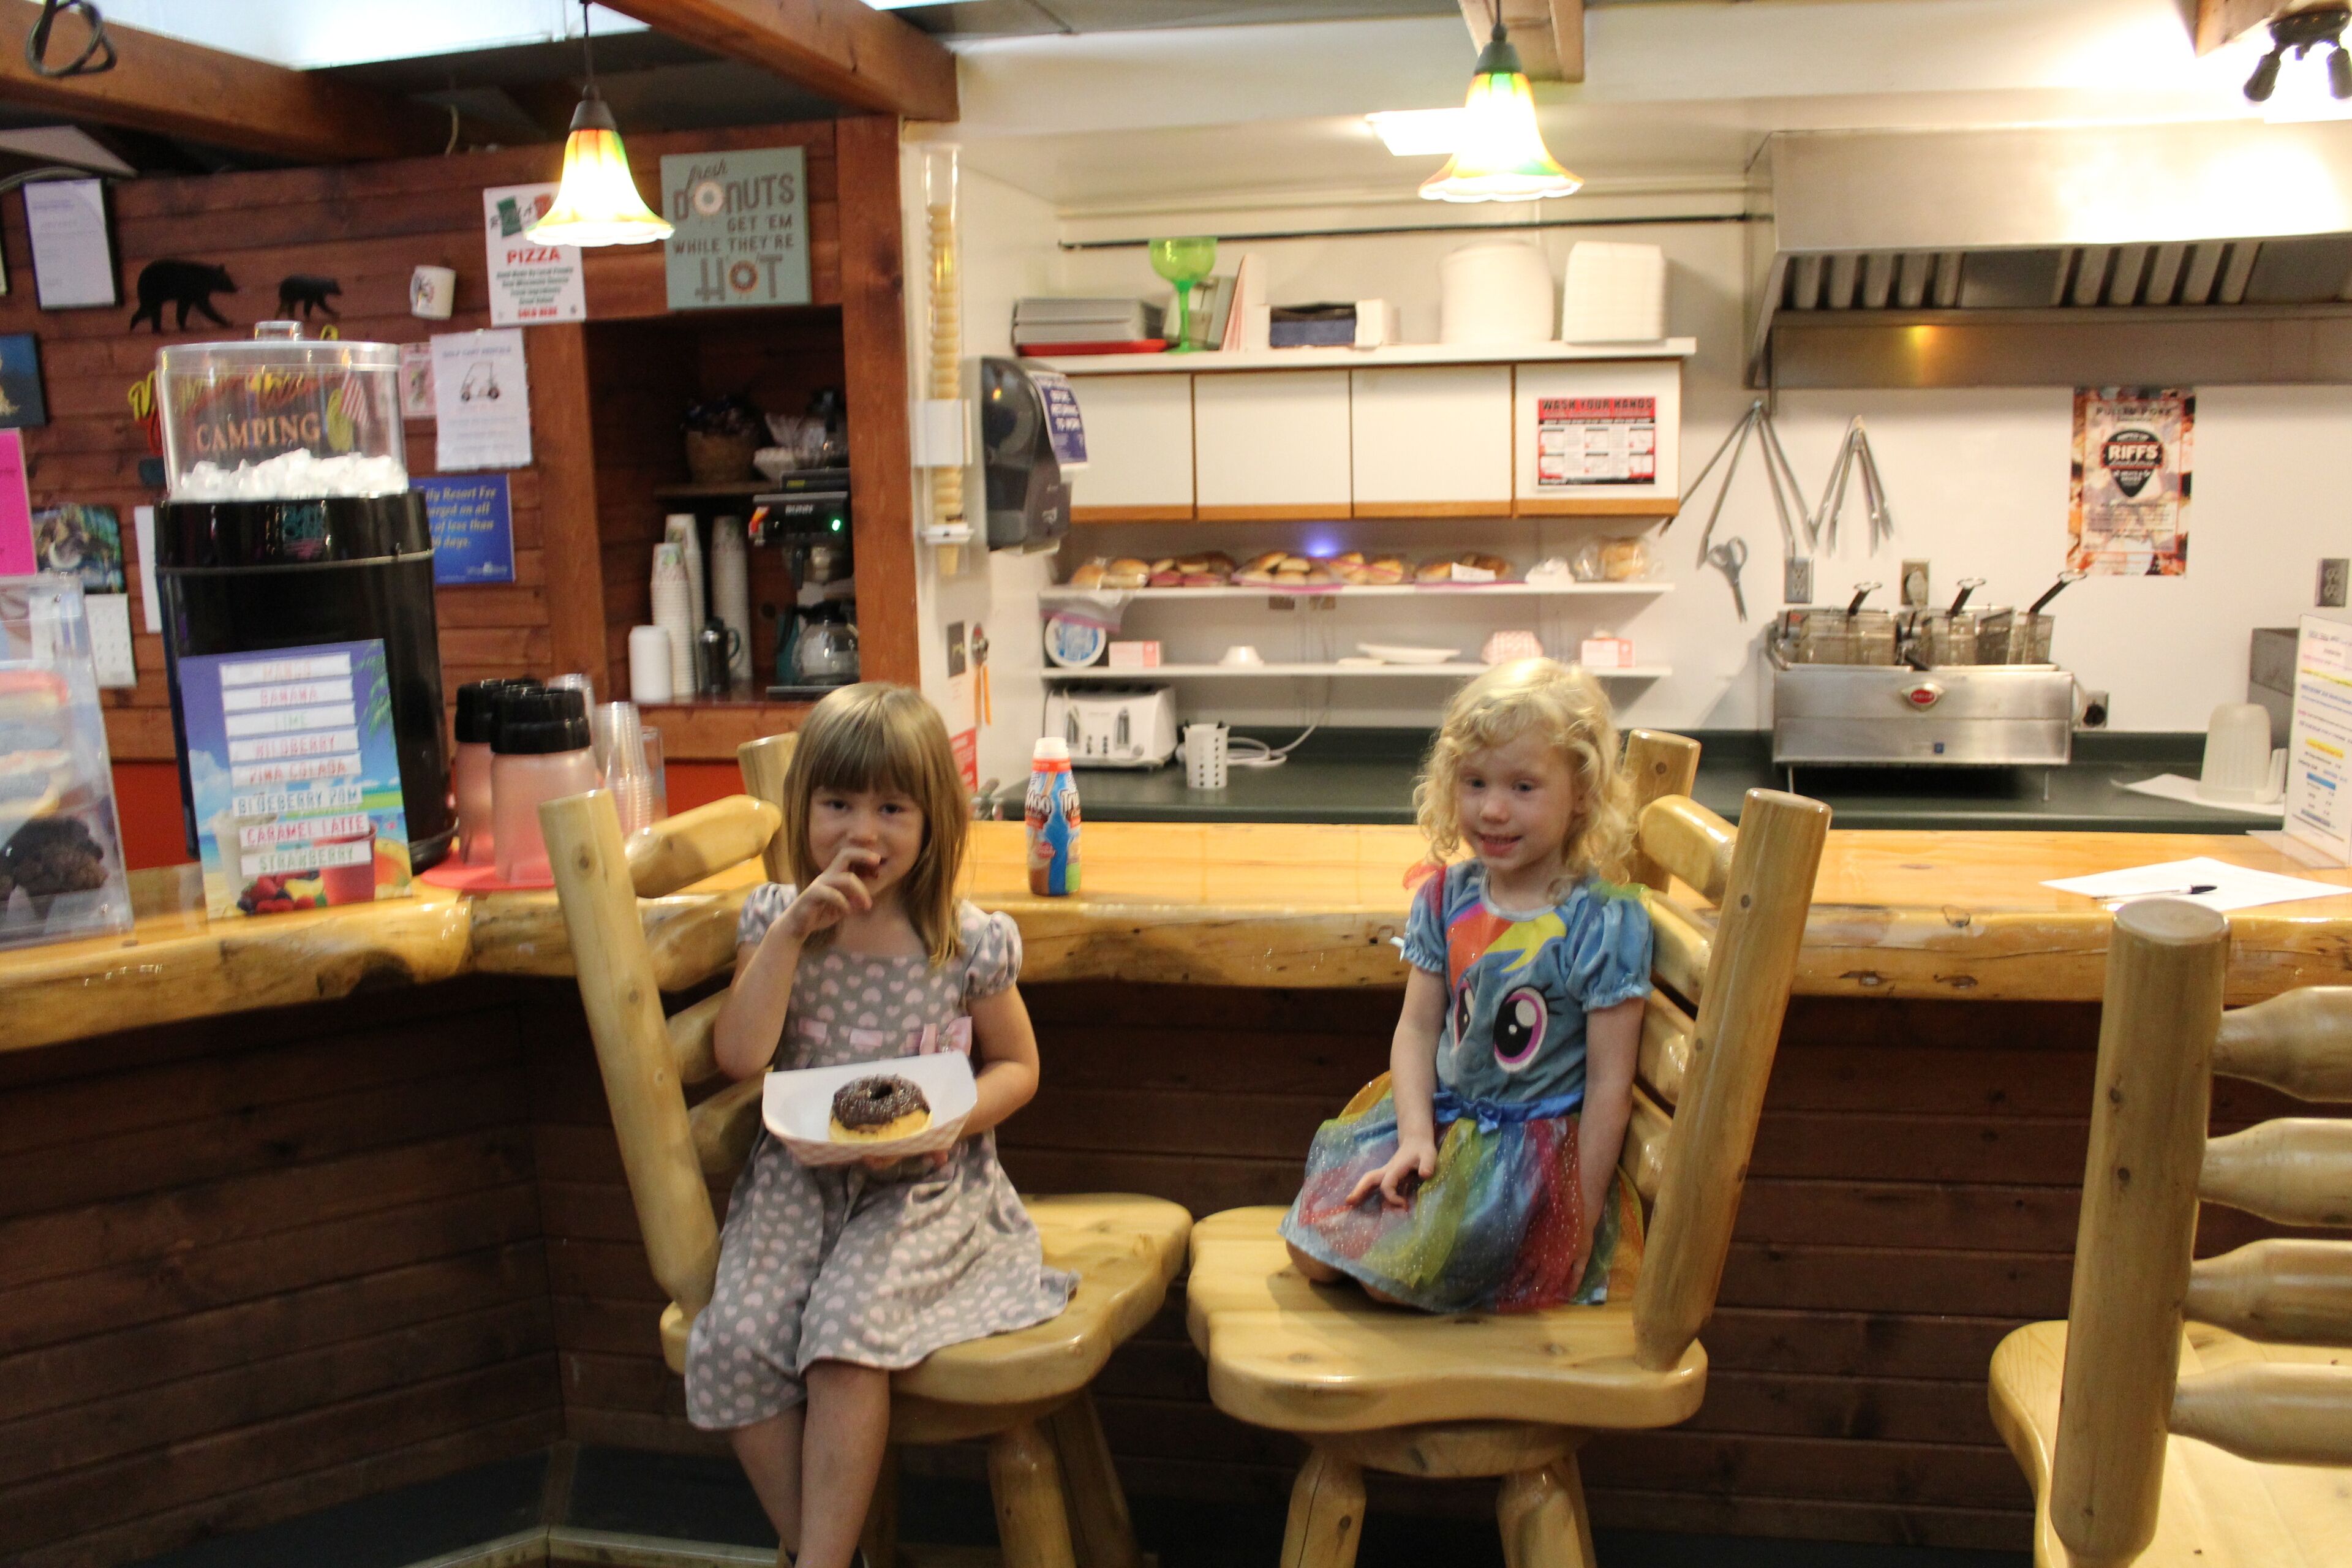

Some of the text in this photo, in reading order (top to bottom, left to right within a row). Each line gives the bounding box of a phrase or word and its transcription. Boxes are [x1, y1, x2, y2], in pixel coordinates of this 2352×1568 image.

[727, 216, 757, 232] GET
[674, 234, 794, 255] WHILE THEY'RE
[507, 247, 561, 265] PIZZA
[695, 253, 783, 302] HOT
[1544, 399, 1652, 409] WASH YOUR HANDS
[195, 410, 322, 453] CAMPING
[2108, 444, 2158, 461] RIFFS
[443, 487, 477, 500] Resort
[475, 502, 491, 515] all
[470, 519, 494, 532] than
[260, 686, 318, 707] BANANA
[256, 736, 336, 758] WILDBERRY
[246, 815, 364, 845] CARAMEL LATTE
[259, 845, 353, 872] STRAWBERRY
